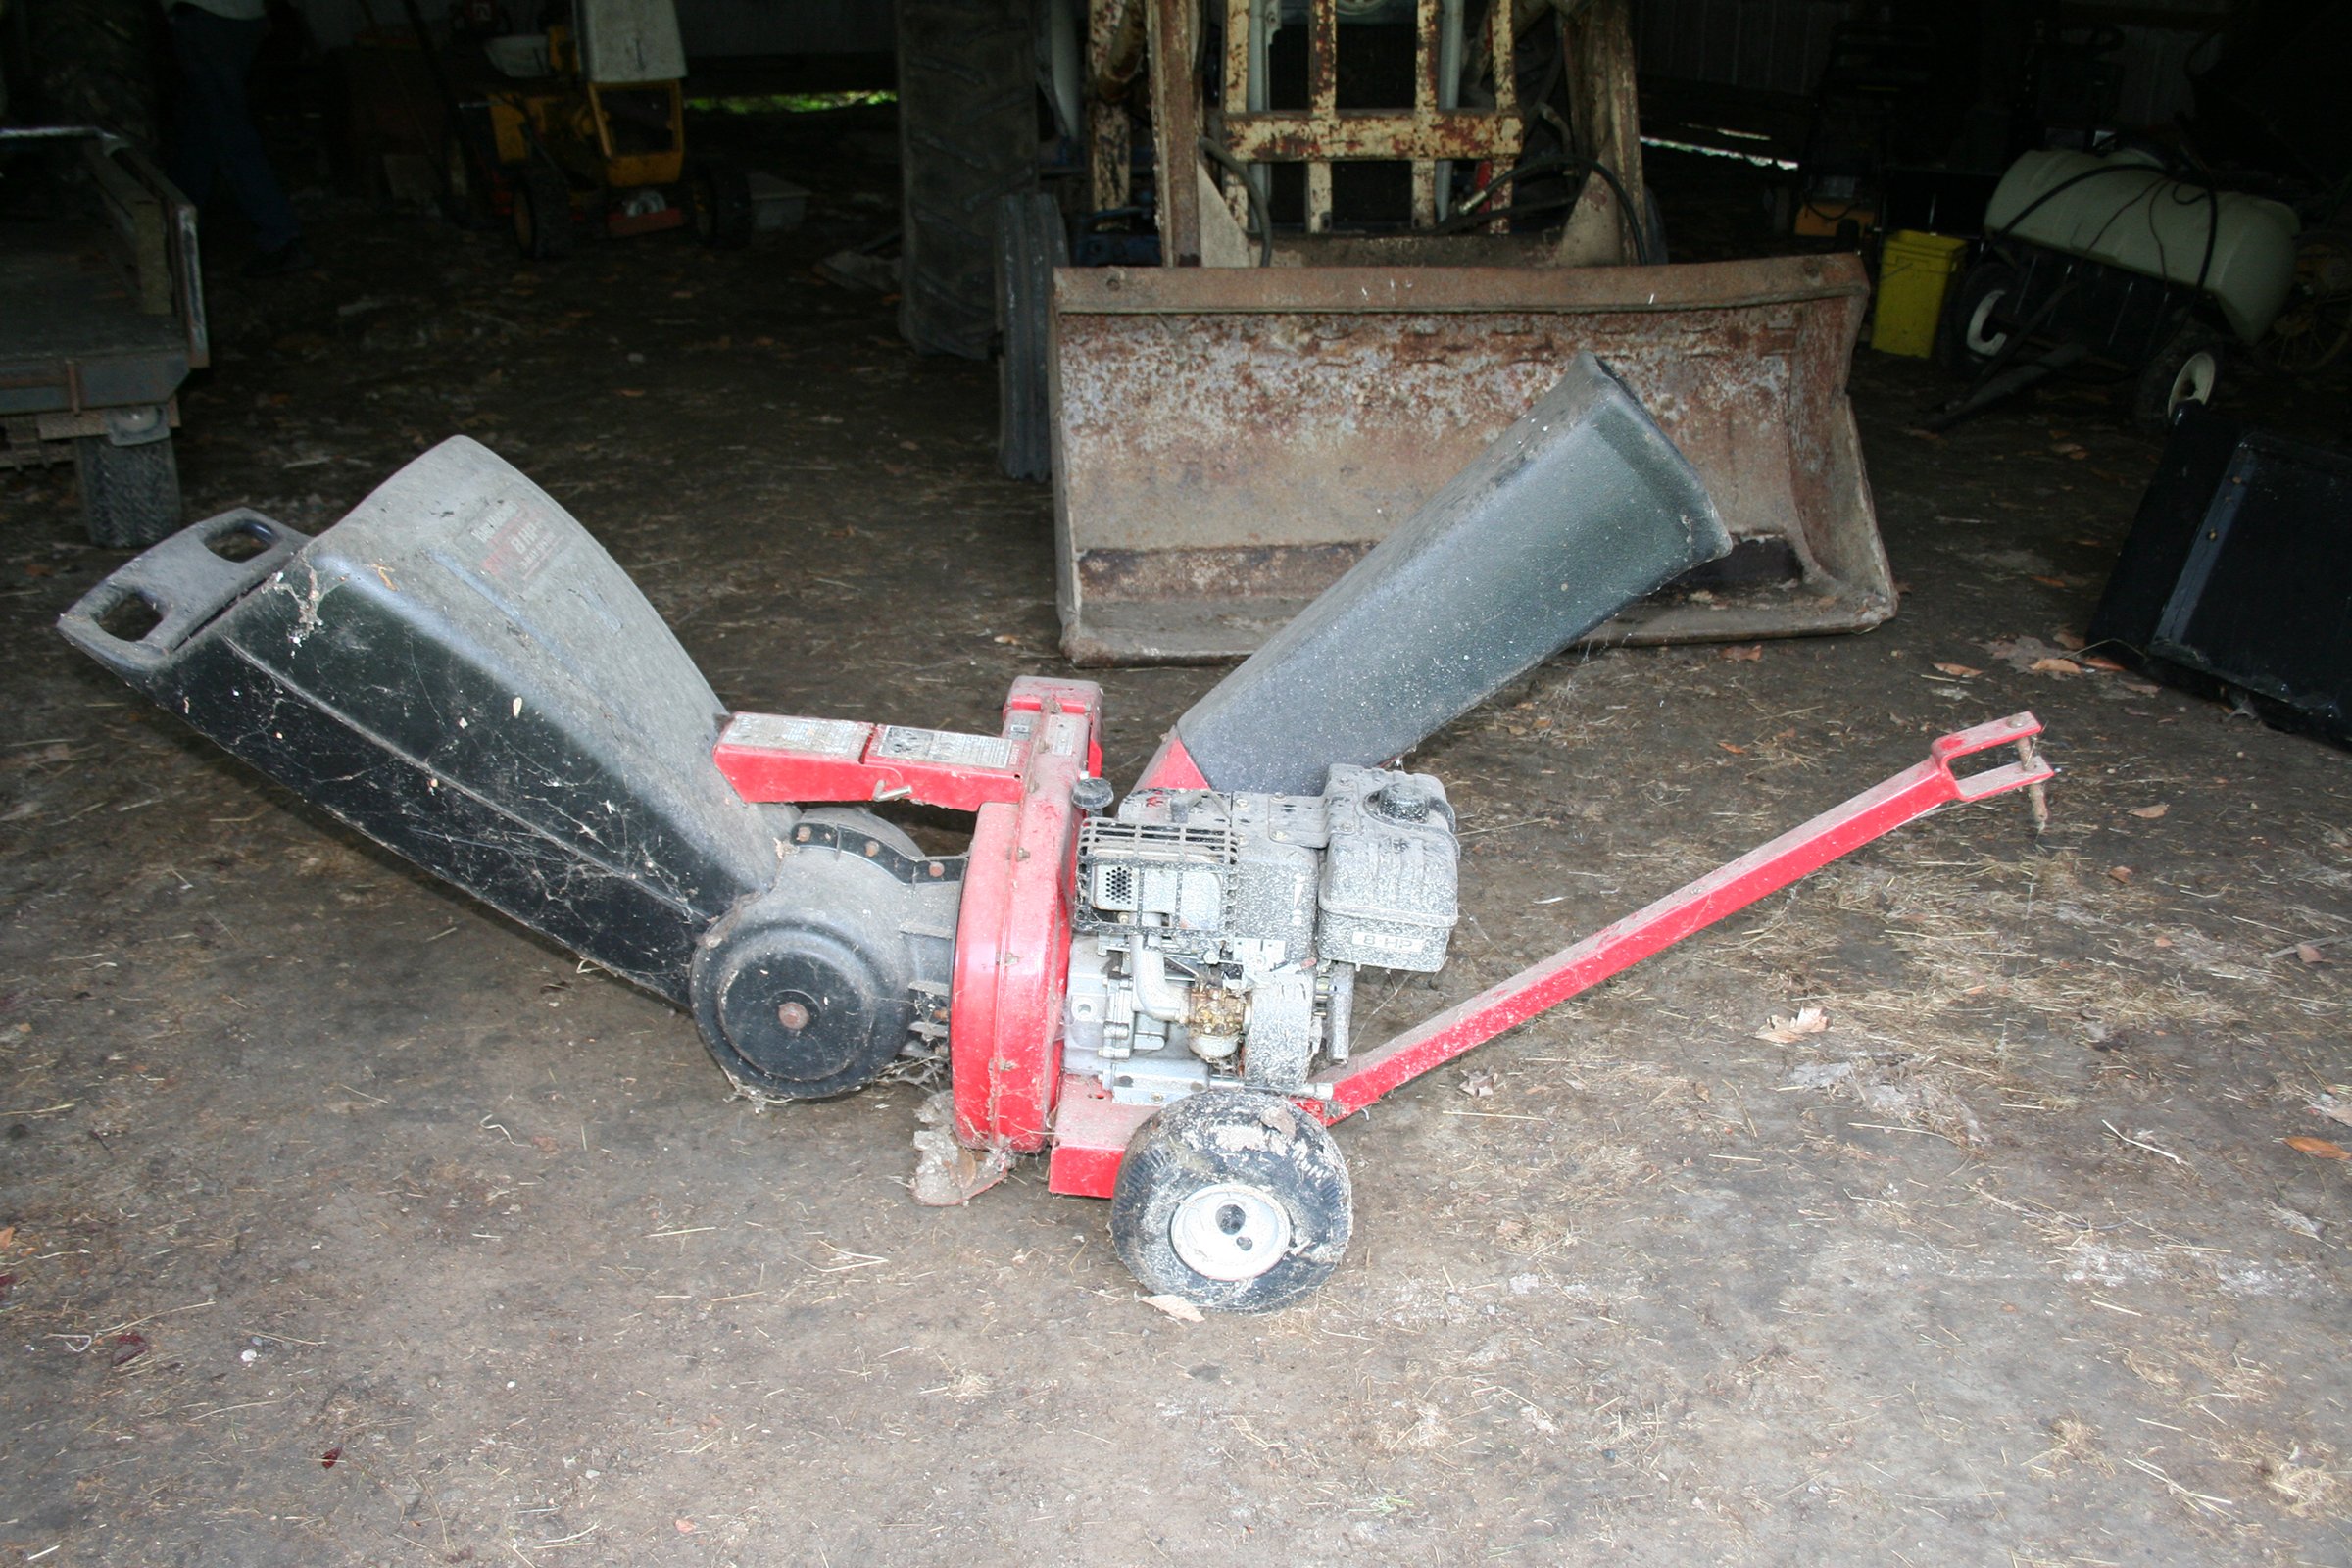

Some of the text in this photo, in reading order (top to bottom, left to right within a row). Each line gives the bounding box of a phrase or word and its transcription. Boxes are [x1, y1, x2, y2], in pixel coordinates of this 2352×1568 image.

[510, 537, 528, 555] 8
[1363, 934, 1412, 949] 8 HP
